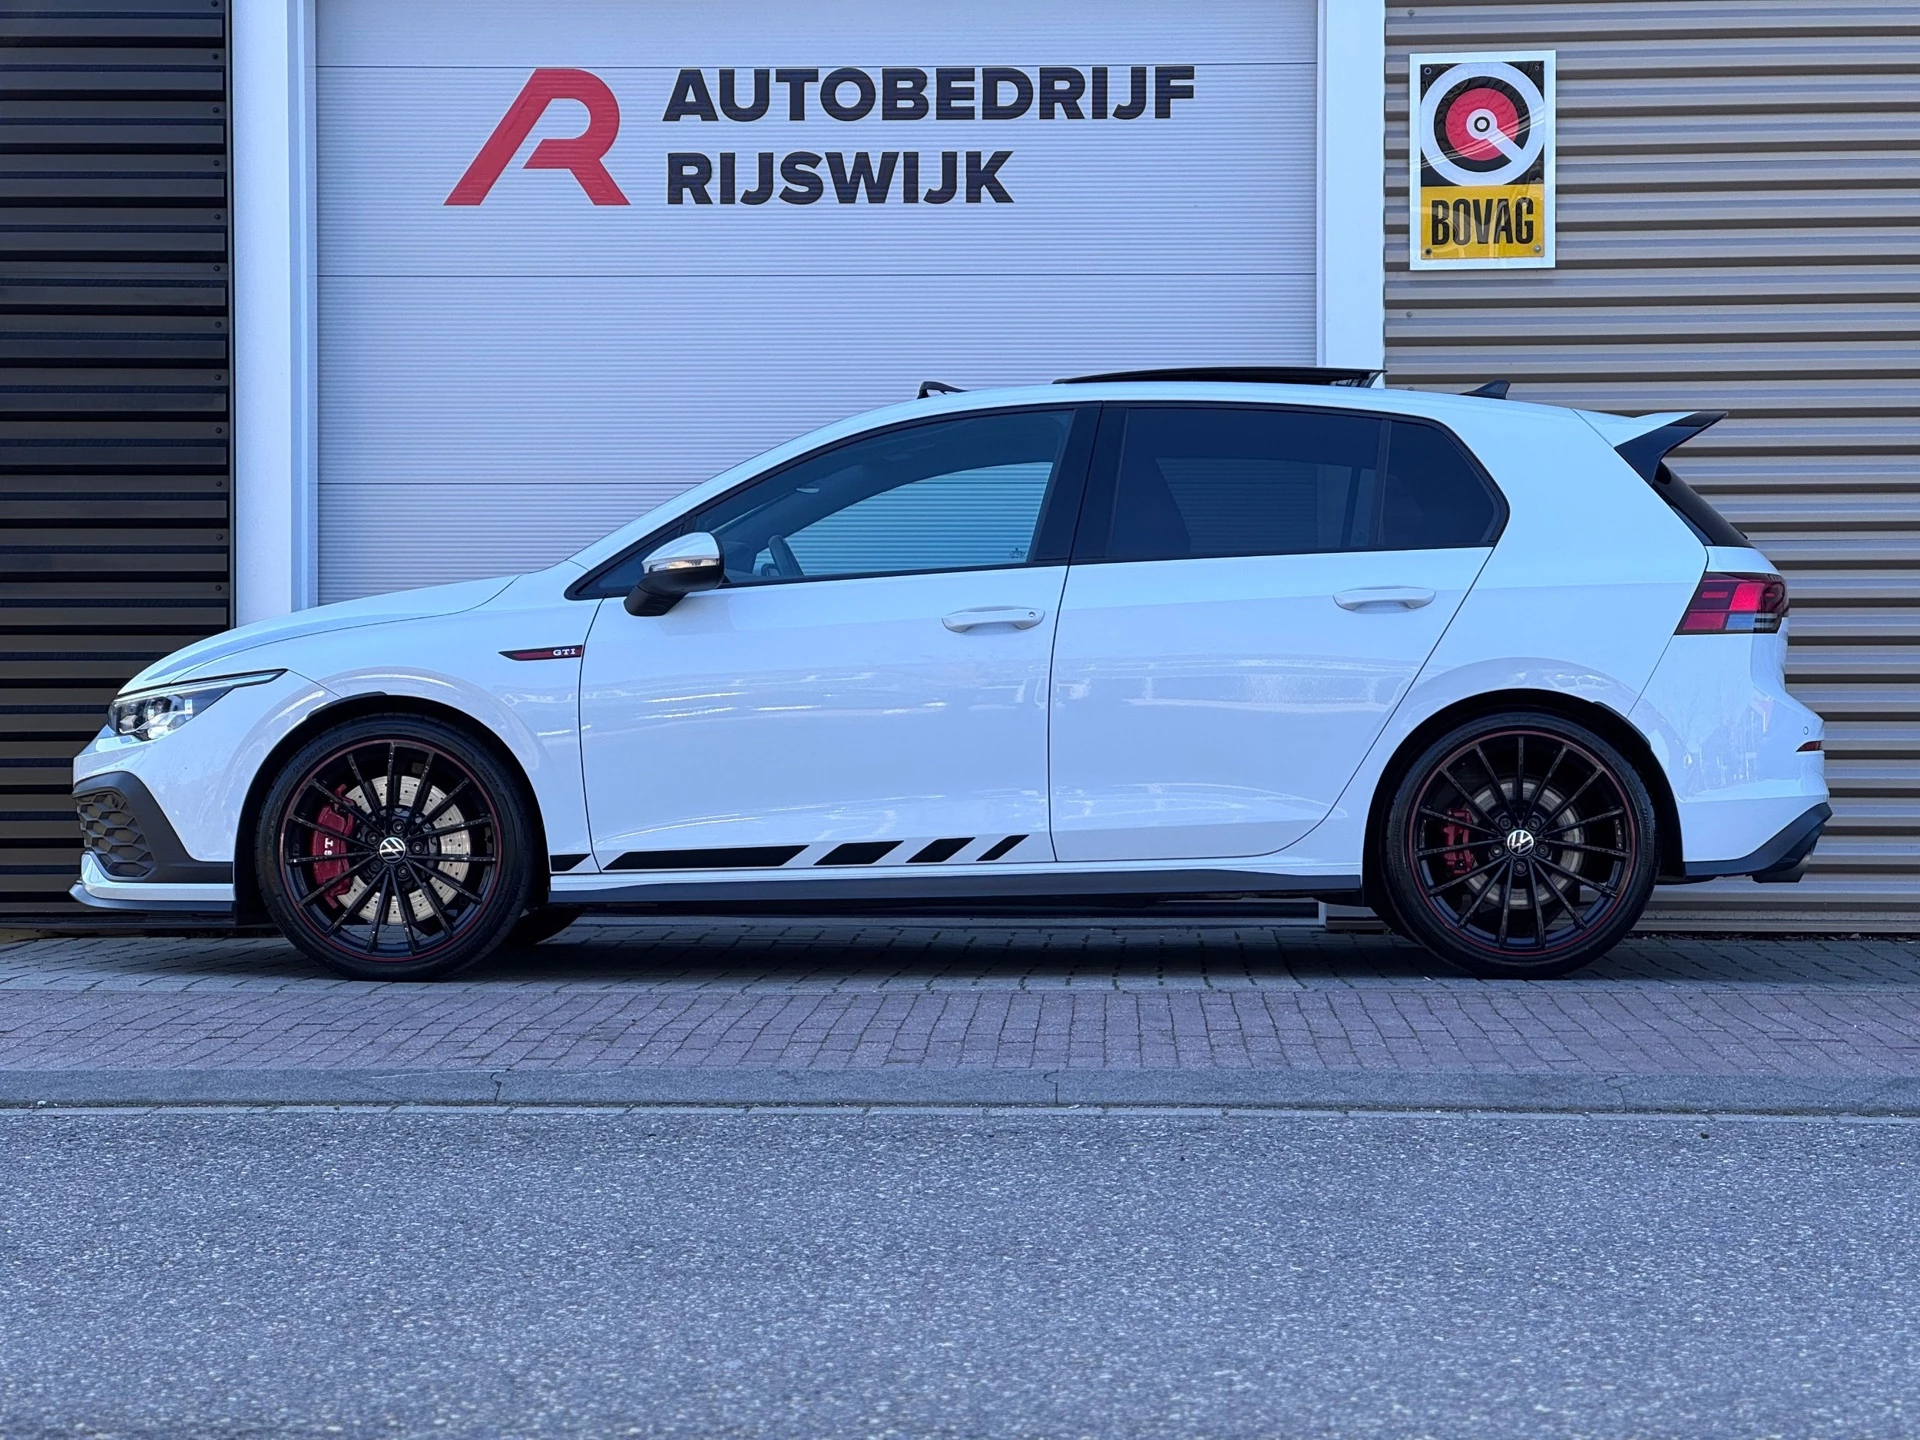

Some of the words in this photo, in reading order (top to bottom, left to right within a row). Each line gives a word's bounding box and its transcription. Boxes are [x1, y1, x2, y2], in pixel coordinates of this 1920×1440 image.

[662, 66, 1196, 122] AUTOBEDRIJF
[667, 150, 1015, 205] RIJSWIJK
[1431, 196, 1534, 246] BOVAG
[553, 648, 576, 656] GTI
[1507, 830, 1534, 856] VW
